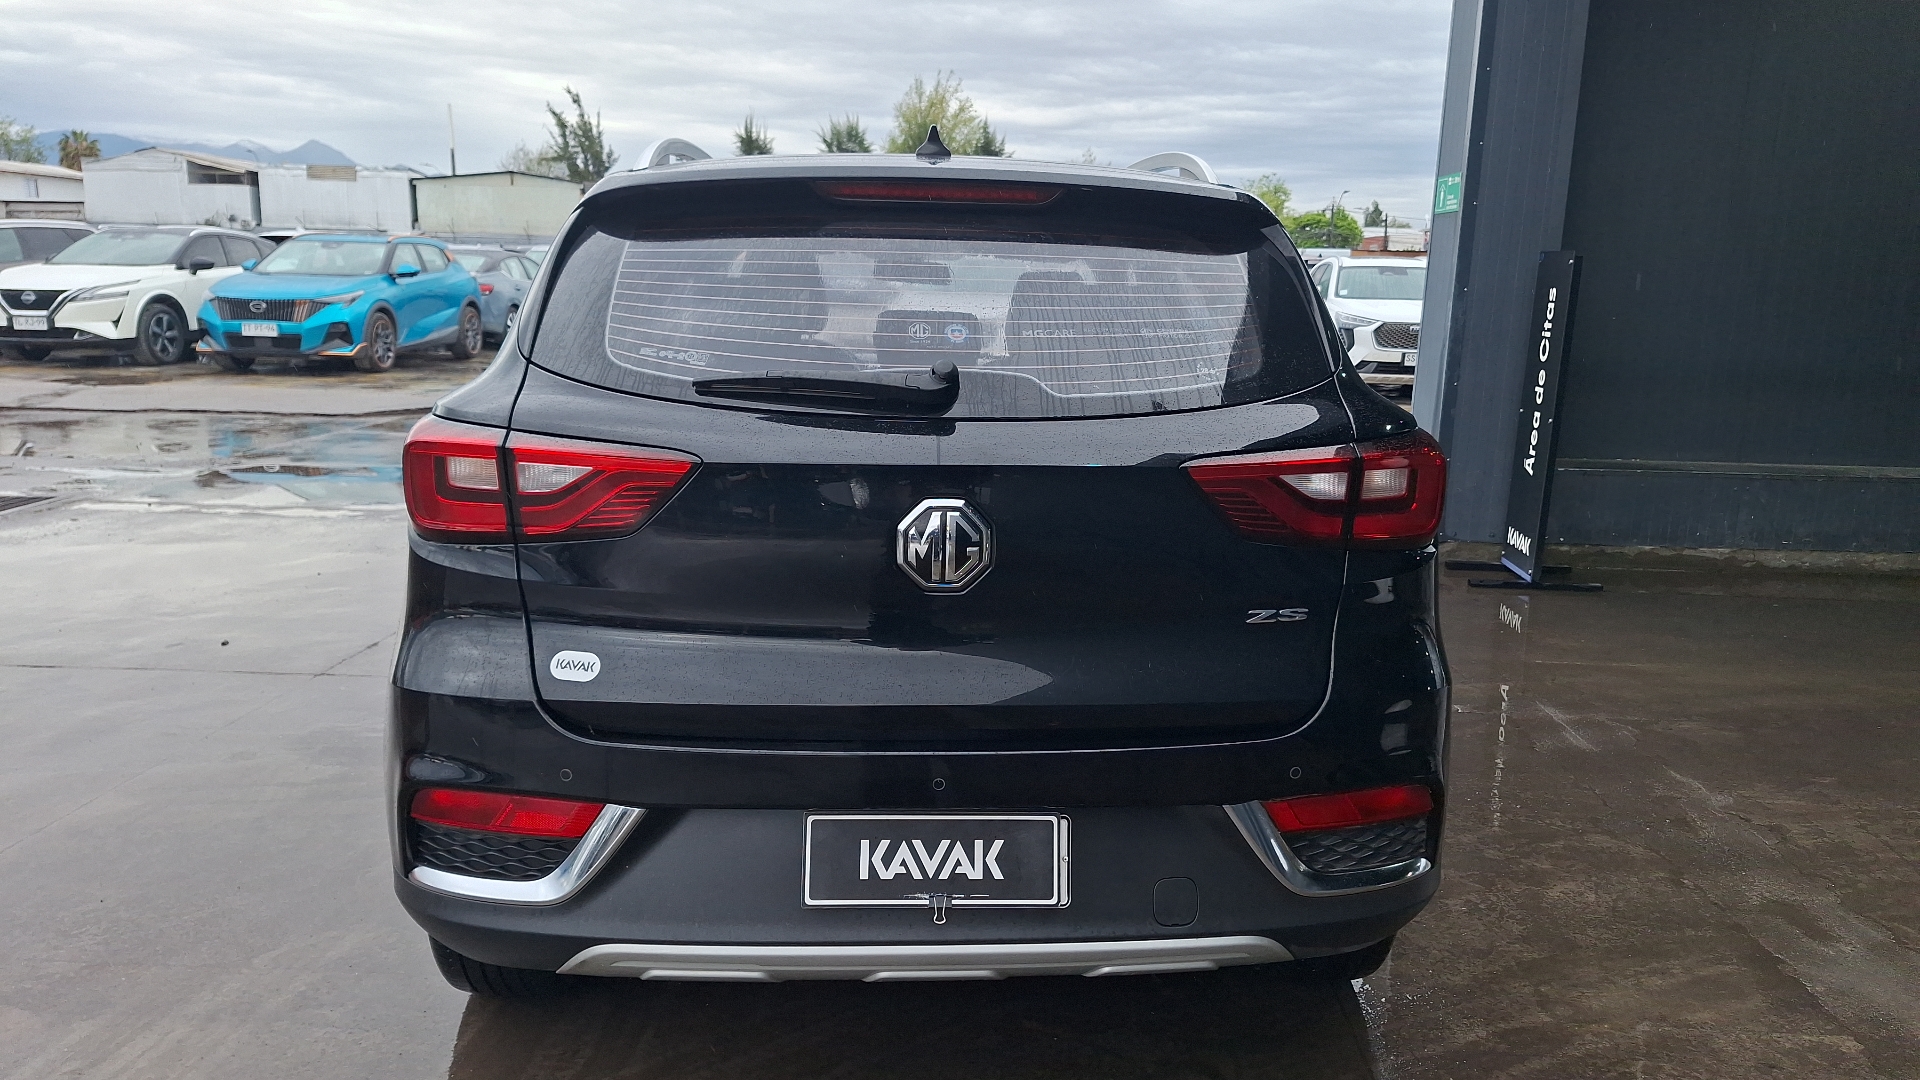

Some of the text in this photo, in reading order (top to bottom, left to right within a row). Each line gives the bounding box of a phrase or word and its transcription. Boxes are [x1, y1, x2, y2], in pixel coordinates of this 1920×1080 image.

[910, 323, 930, 338] MG
[1523, 287, 1557, 477] Área de Citas
[906, 510, 981, 583] MG
[1507, 526, 1532, 557] KAVAK
[1245, 608, 1309, 624] ZS
[555, 658, 597, 673] KAVAK
[859, 839, 1005, 880] KAVAK
